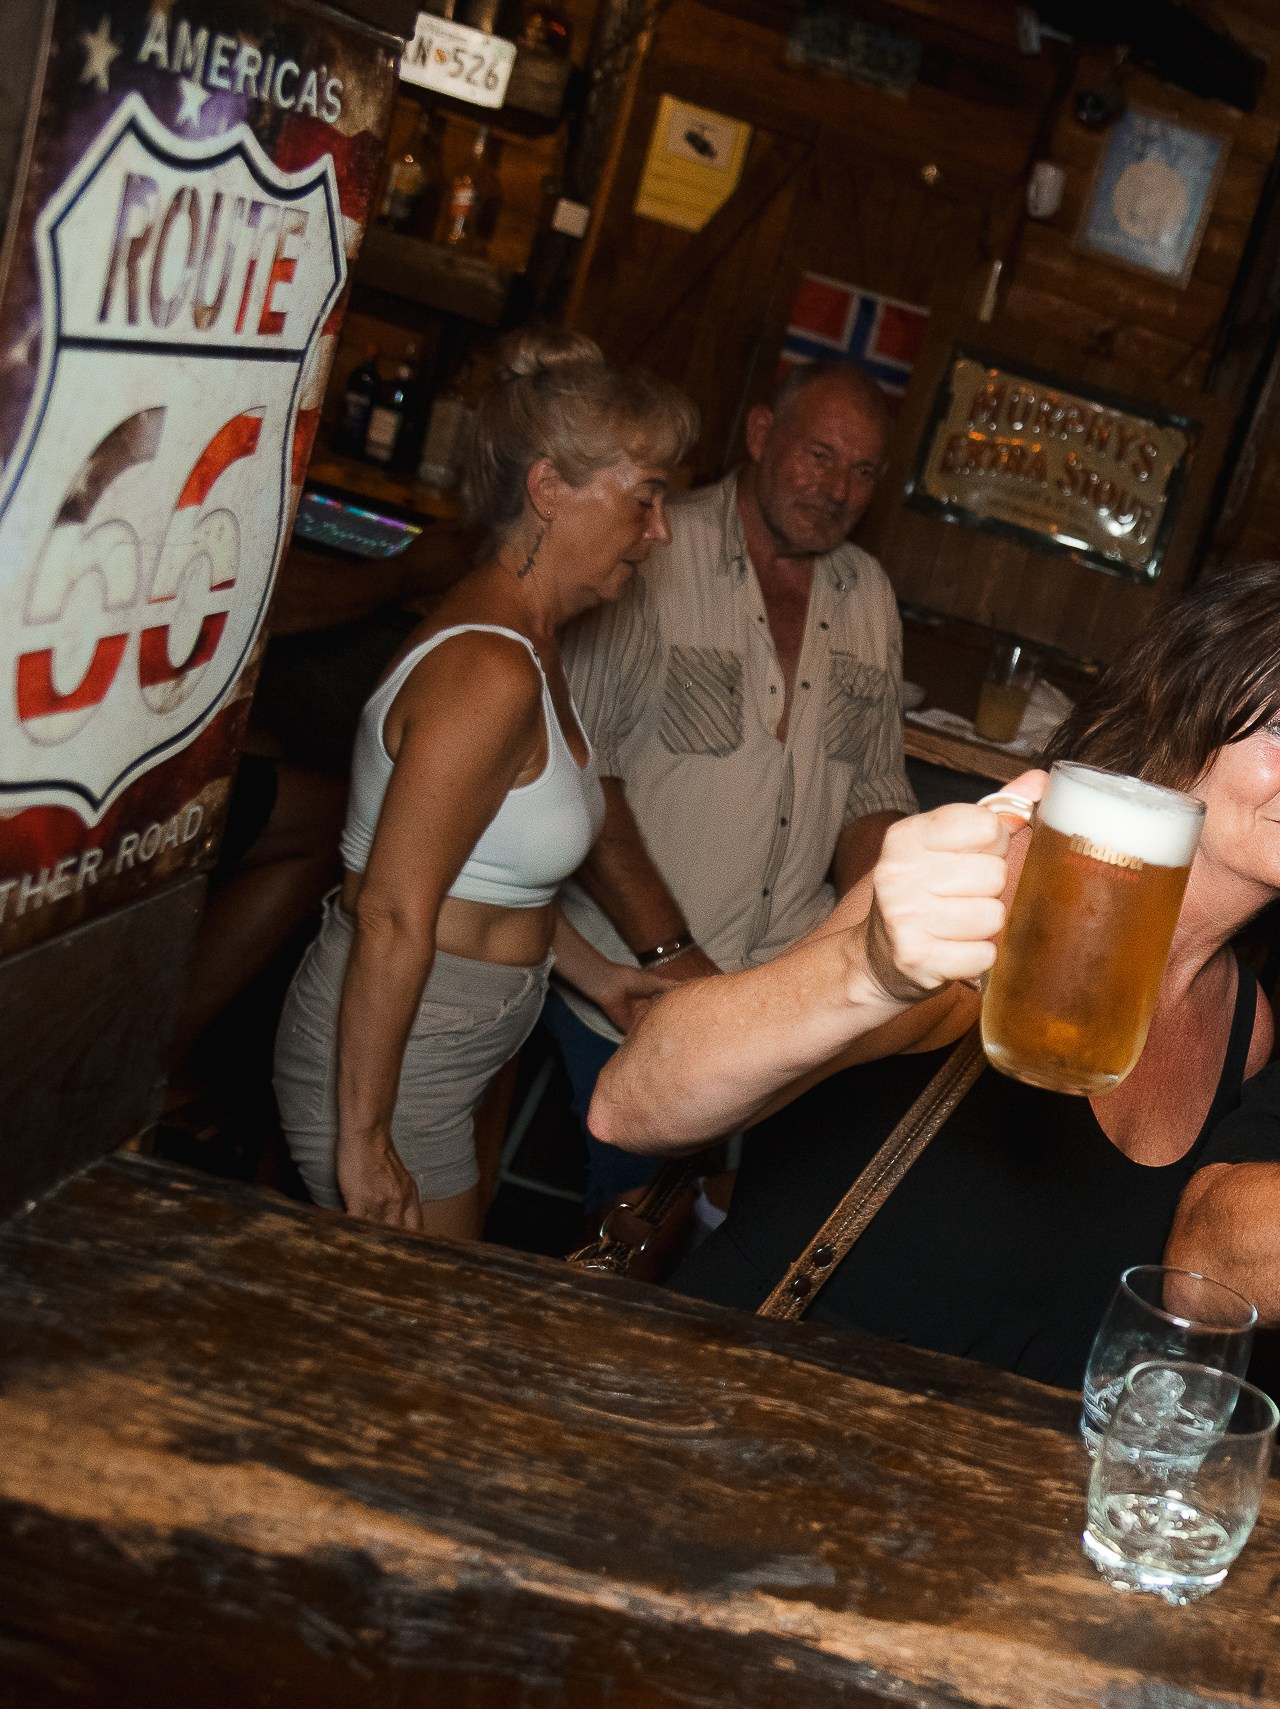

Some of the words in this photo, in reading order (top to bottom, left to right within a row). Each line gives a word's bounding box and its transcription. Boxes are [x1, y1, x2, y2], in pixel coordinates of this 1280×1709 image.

[137, 10, 344, 124] AMERICA'S
[448, 46, 500, 92] 526
[99, 173, 311, 336] ROUTE
[941, 434, 1049, 482] EXTRA
[1057, 452, 1148, 544] STOUT
[17, 405, 267, 747] 66
[113, 804, 206, 876] ROAD
